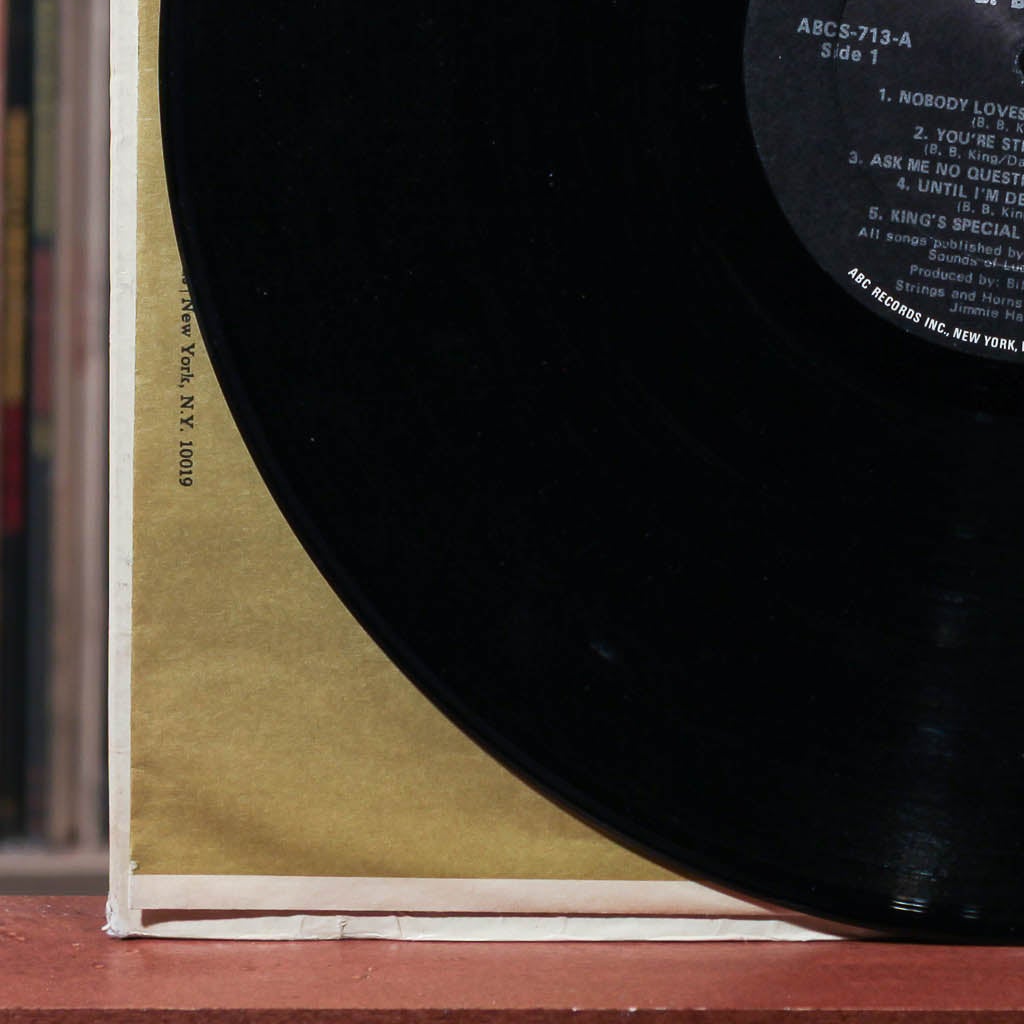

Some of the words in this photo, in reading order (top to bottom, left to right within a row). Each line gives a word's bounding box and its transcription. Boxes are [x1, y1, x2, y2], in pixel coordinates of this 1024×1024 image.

[797, 17, 912, 48] ABCS-713-A
[820, 42, 862, 62] Side
[870, 48, 878, 64] 1
[879, 88, 892, 102] 1.
[898, 90, 968, 112] NOBODY
[972, 116, 989, 128] (B.
[996, 120, 1008, 132] B.
[913, 126, 928, 140] 2.
[936, 128, 996, 149] YOU'RE
[848, 151, 863, 165] 3.
[870, 153, 902, 170] ASK
[907, 158, 930, 174] ME
[936, 162, 961, 178] NO
[924, 144, 942, 156] (B.
[949, 146, 961, 159] B.
[896, 176, 910, 191] 4.
[918, 178, 968, 198] UNTIL
[974, 186, 1000, 202] I'M
[957, 201, 975, 214] (B.
[982, 204, 994, 216] B.
[868, 206, 883, 221] 5.
[890, 208, 947, 229] KING'S
[952, 217, 1020, 240] SPECIAL
[858, 227, 880, 240] All
[886, 232, 927, 246] songs
[933, 238, 1002, 256] published
[1008, 246, 1024, 260] by
[928, 249, 977, 266] Sounds
[910, 264, 973, 284] Produced
[978, 272, 1000, 288] by:
[896, 279, 946, 298] Strings
[952, 288, 976, 302] and
[982, 292, 1022, 308] Horns
[181, 298, 194, 338] New
[848, 267, 872, 290] ABC
[871, 286, 922, 324] RECORDS
[924, 317, 950, 336] INC.,
[952, 328, 981, 344] NEW
[984, 335, 1018, 352] YORK,
[949, 302, 1000, 318] Jimmie
[178, 342, 195, 388] York,
[180, 395, 194, 432] N.Y.
[179, 440, 194, 487] 10019
